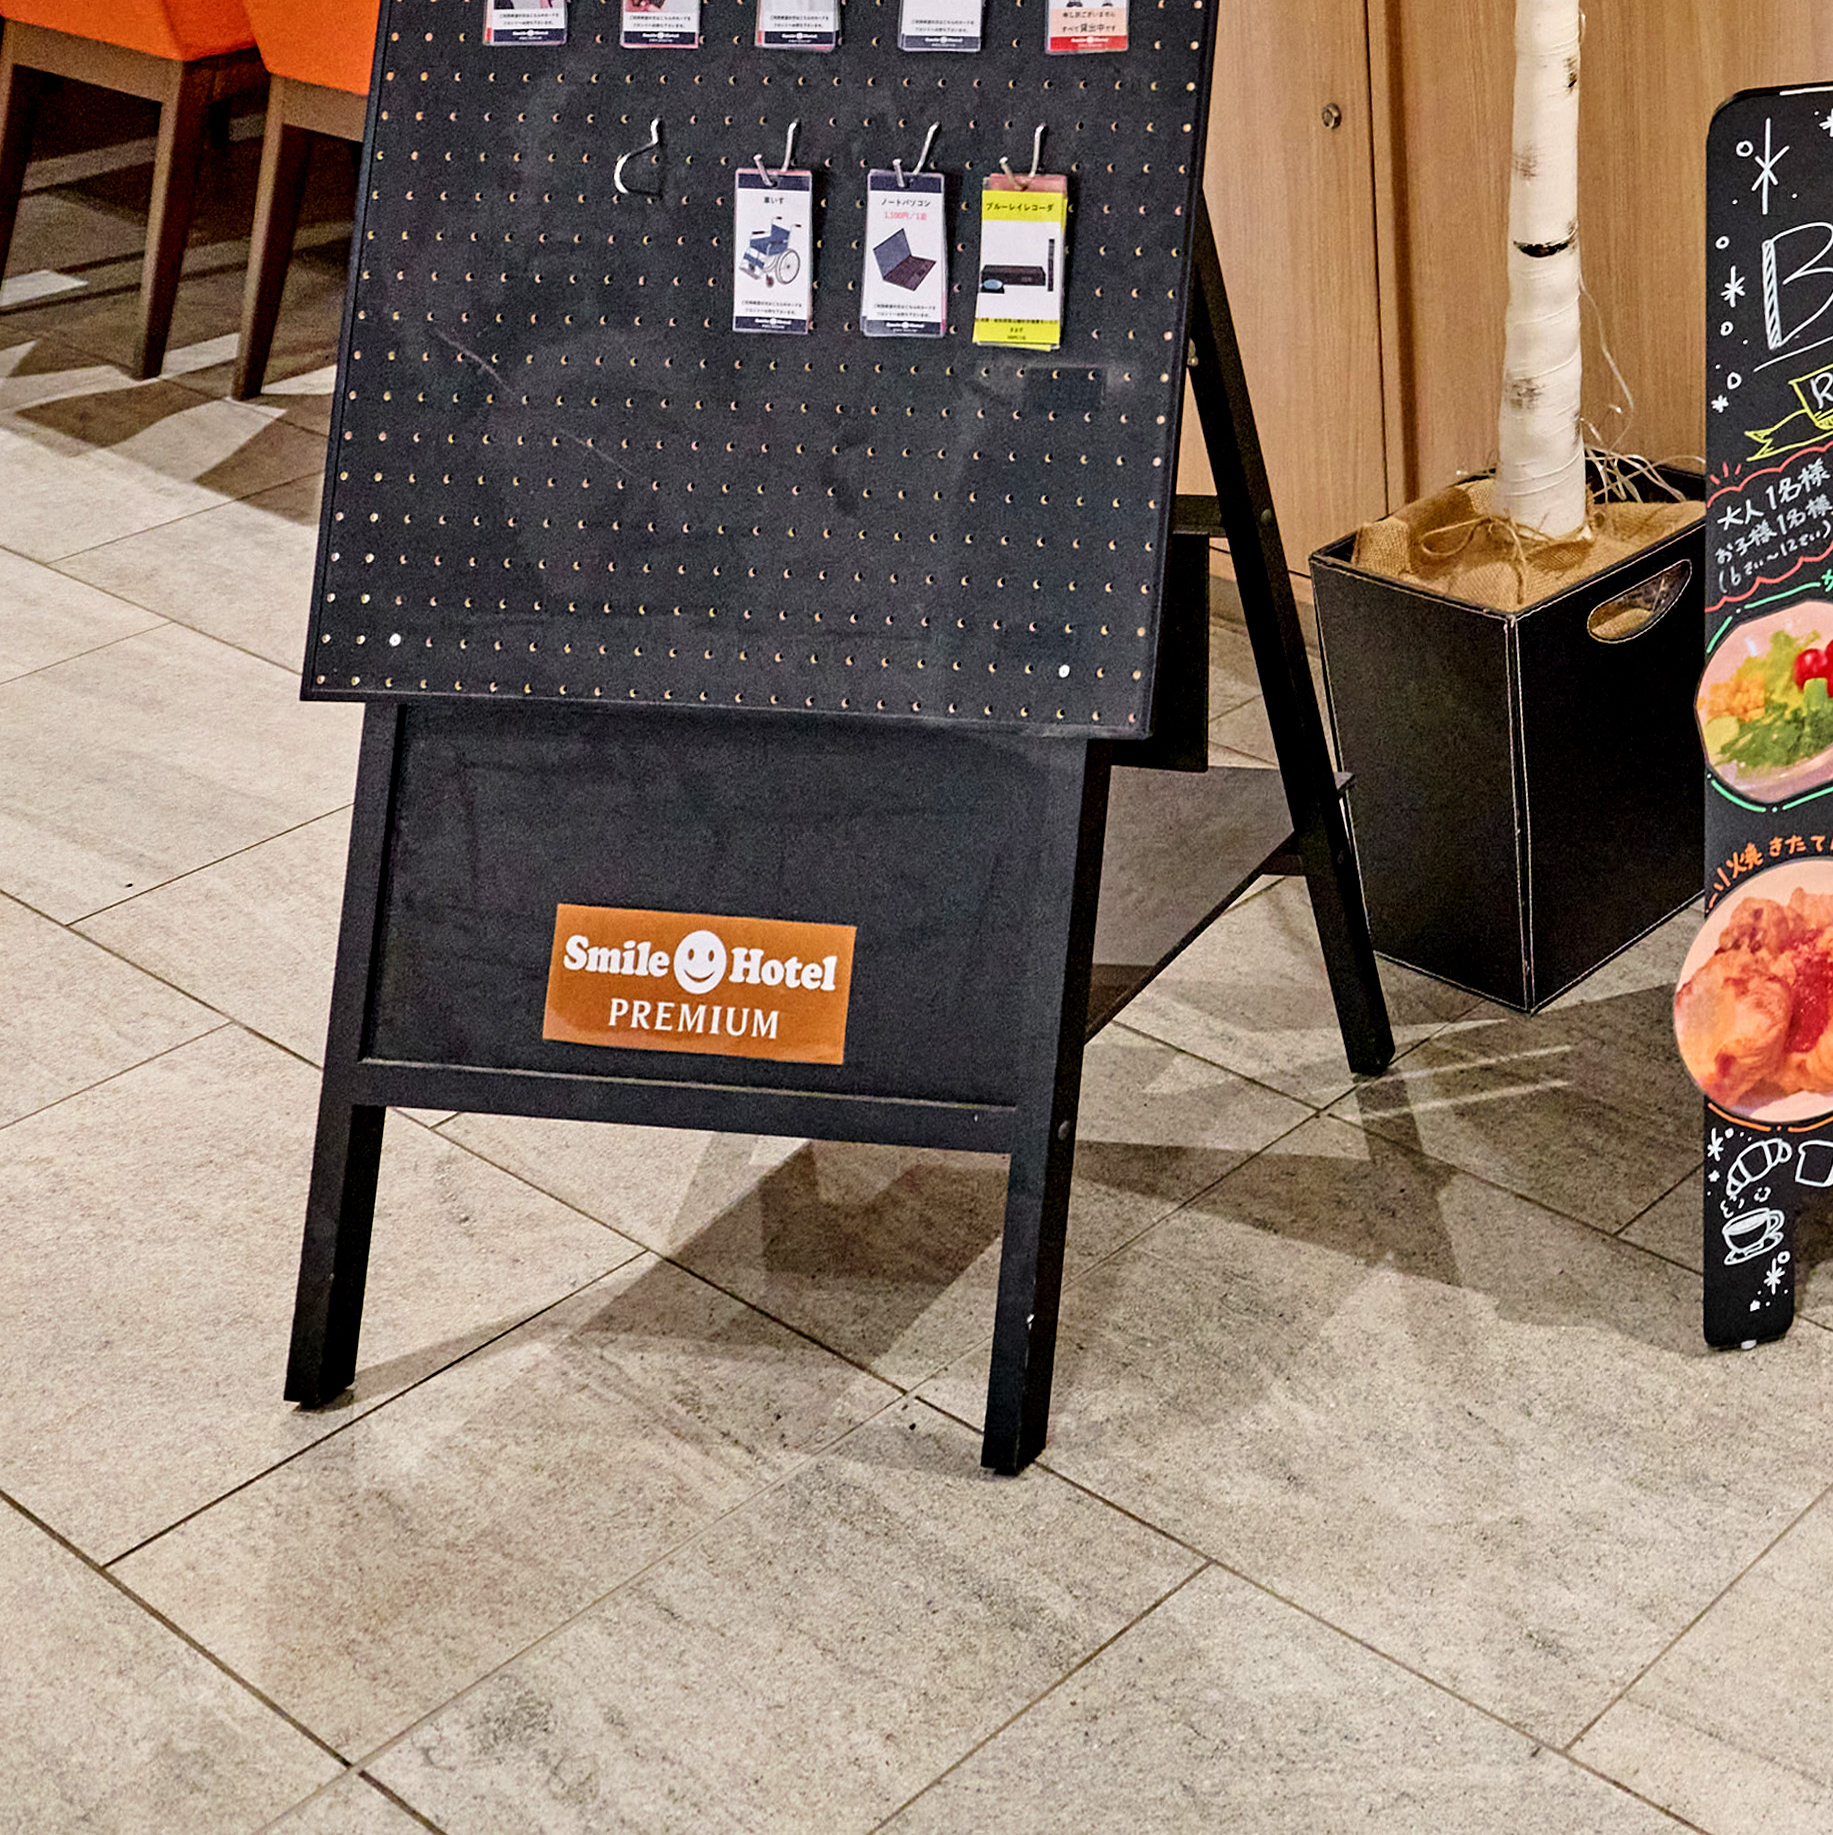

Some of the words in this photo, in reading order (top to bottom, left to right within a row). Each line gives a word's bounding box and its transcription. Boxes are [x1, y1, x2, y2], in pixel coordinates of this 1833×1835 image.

[563, 935, 670, 977] Smile
[728, 947, 838, 992] Hotel
[608, 998, 779, 1039] PREMIUM
